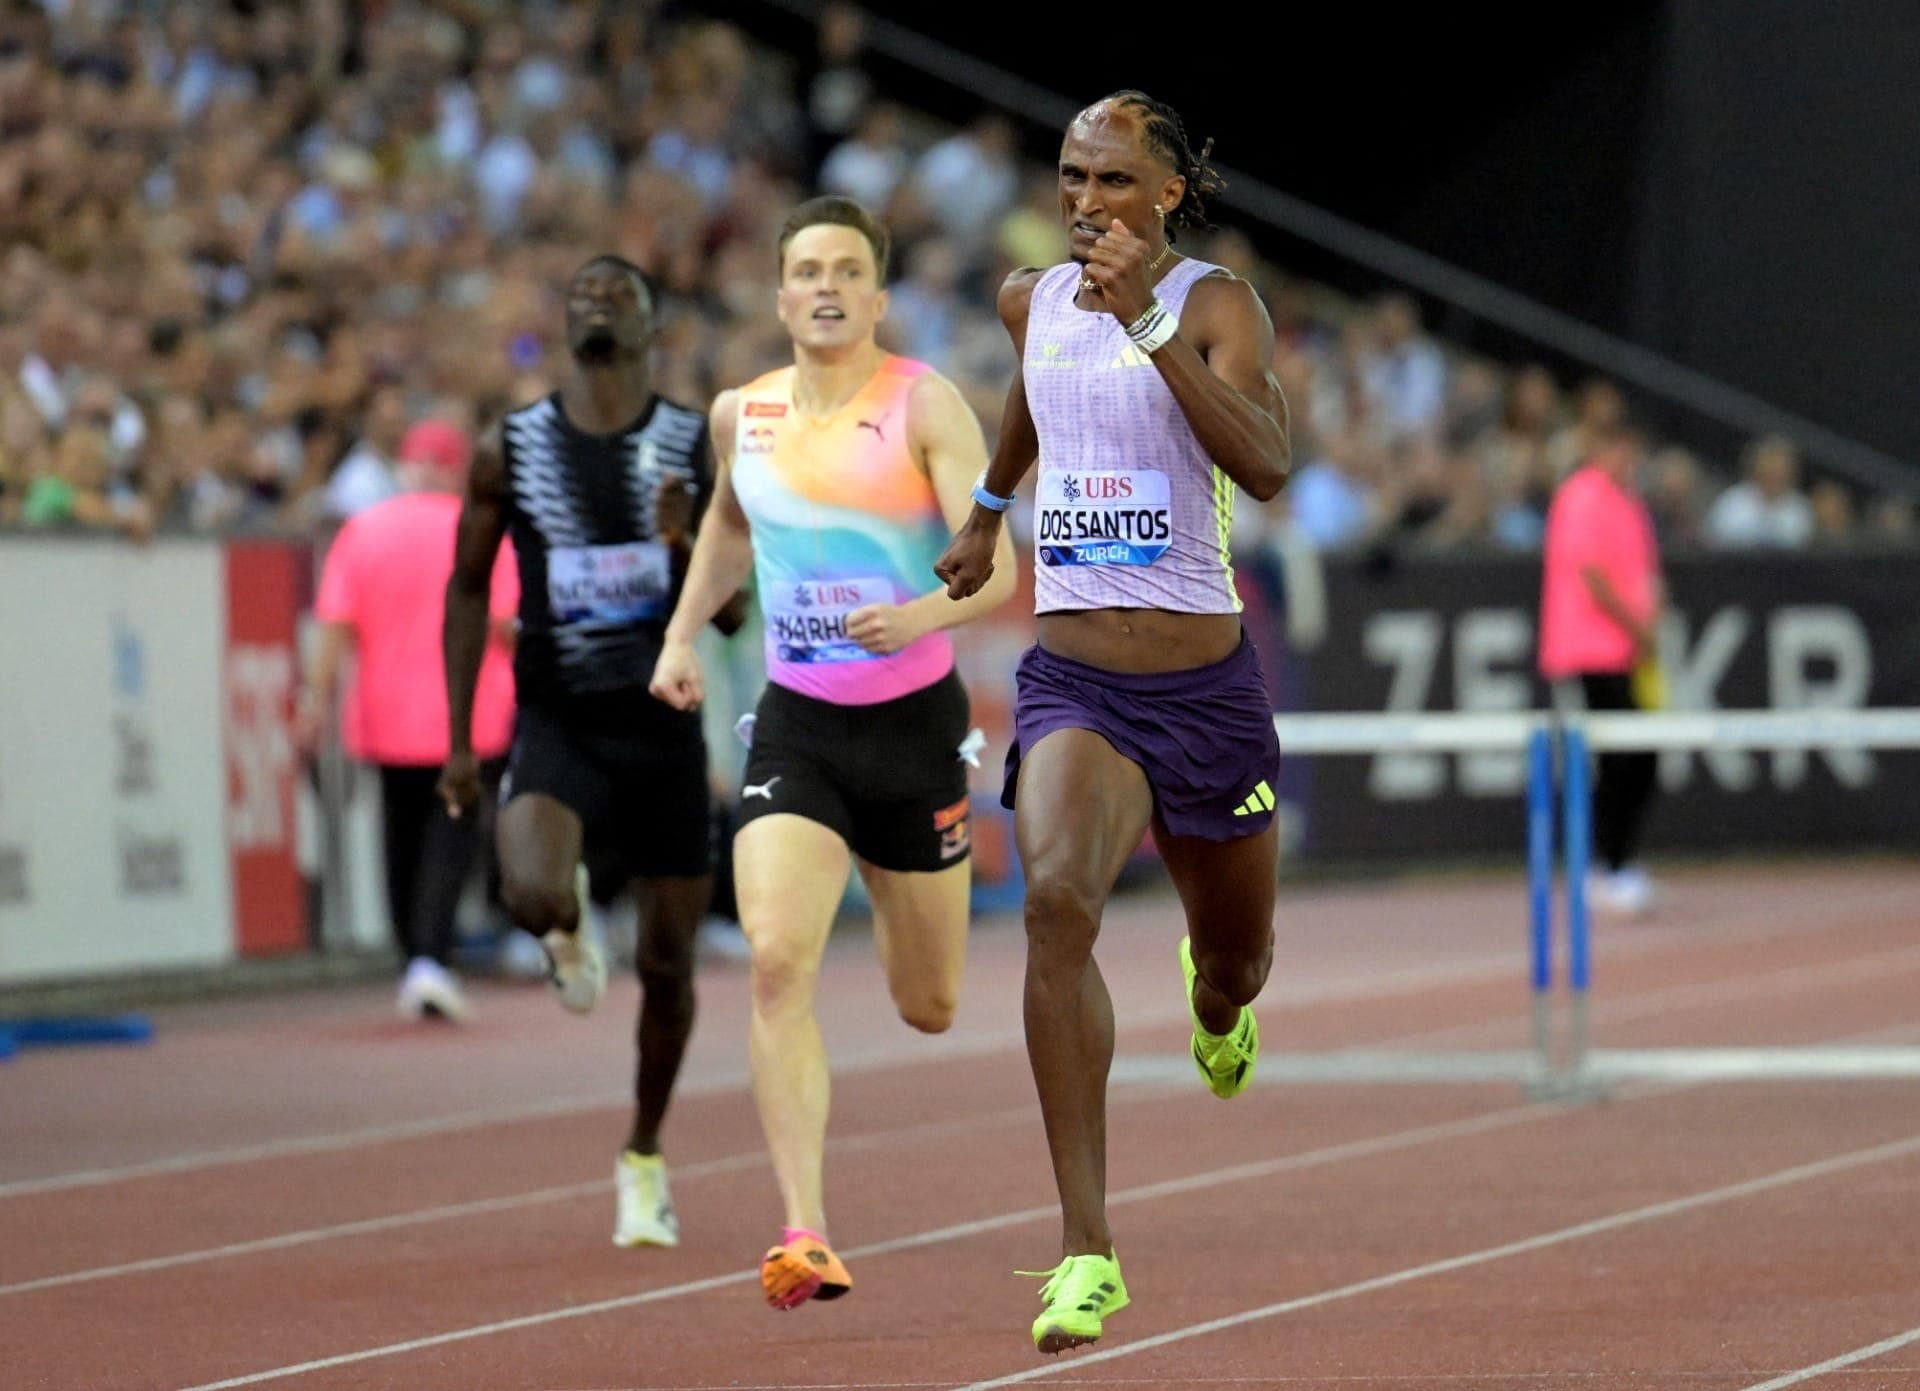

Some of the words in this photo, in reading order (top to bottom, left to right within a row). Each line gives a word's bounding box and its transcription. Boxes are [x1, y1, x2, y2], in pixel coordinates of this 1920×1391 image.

[1085, 477, 1133, 498] UBS
[1040, 509, 1072, 540] DOS
[1075, 509, 1169, 540] SANTOS
[1075, 545, 1129, 563] ZURICH
[817, 584, 861, 605] UBS
